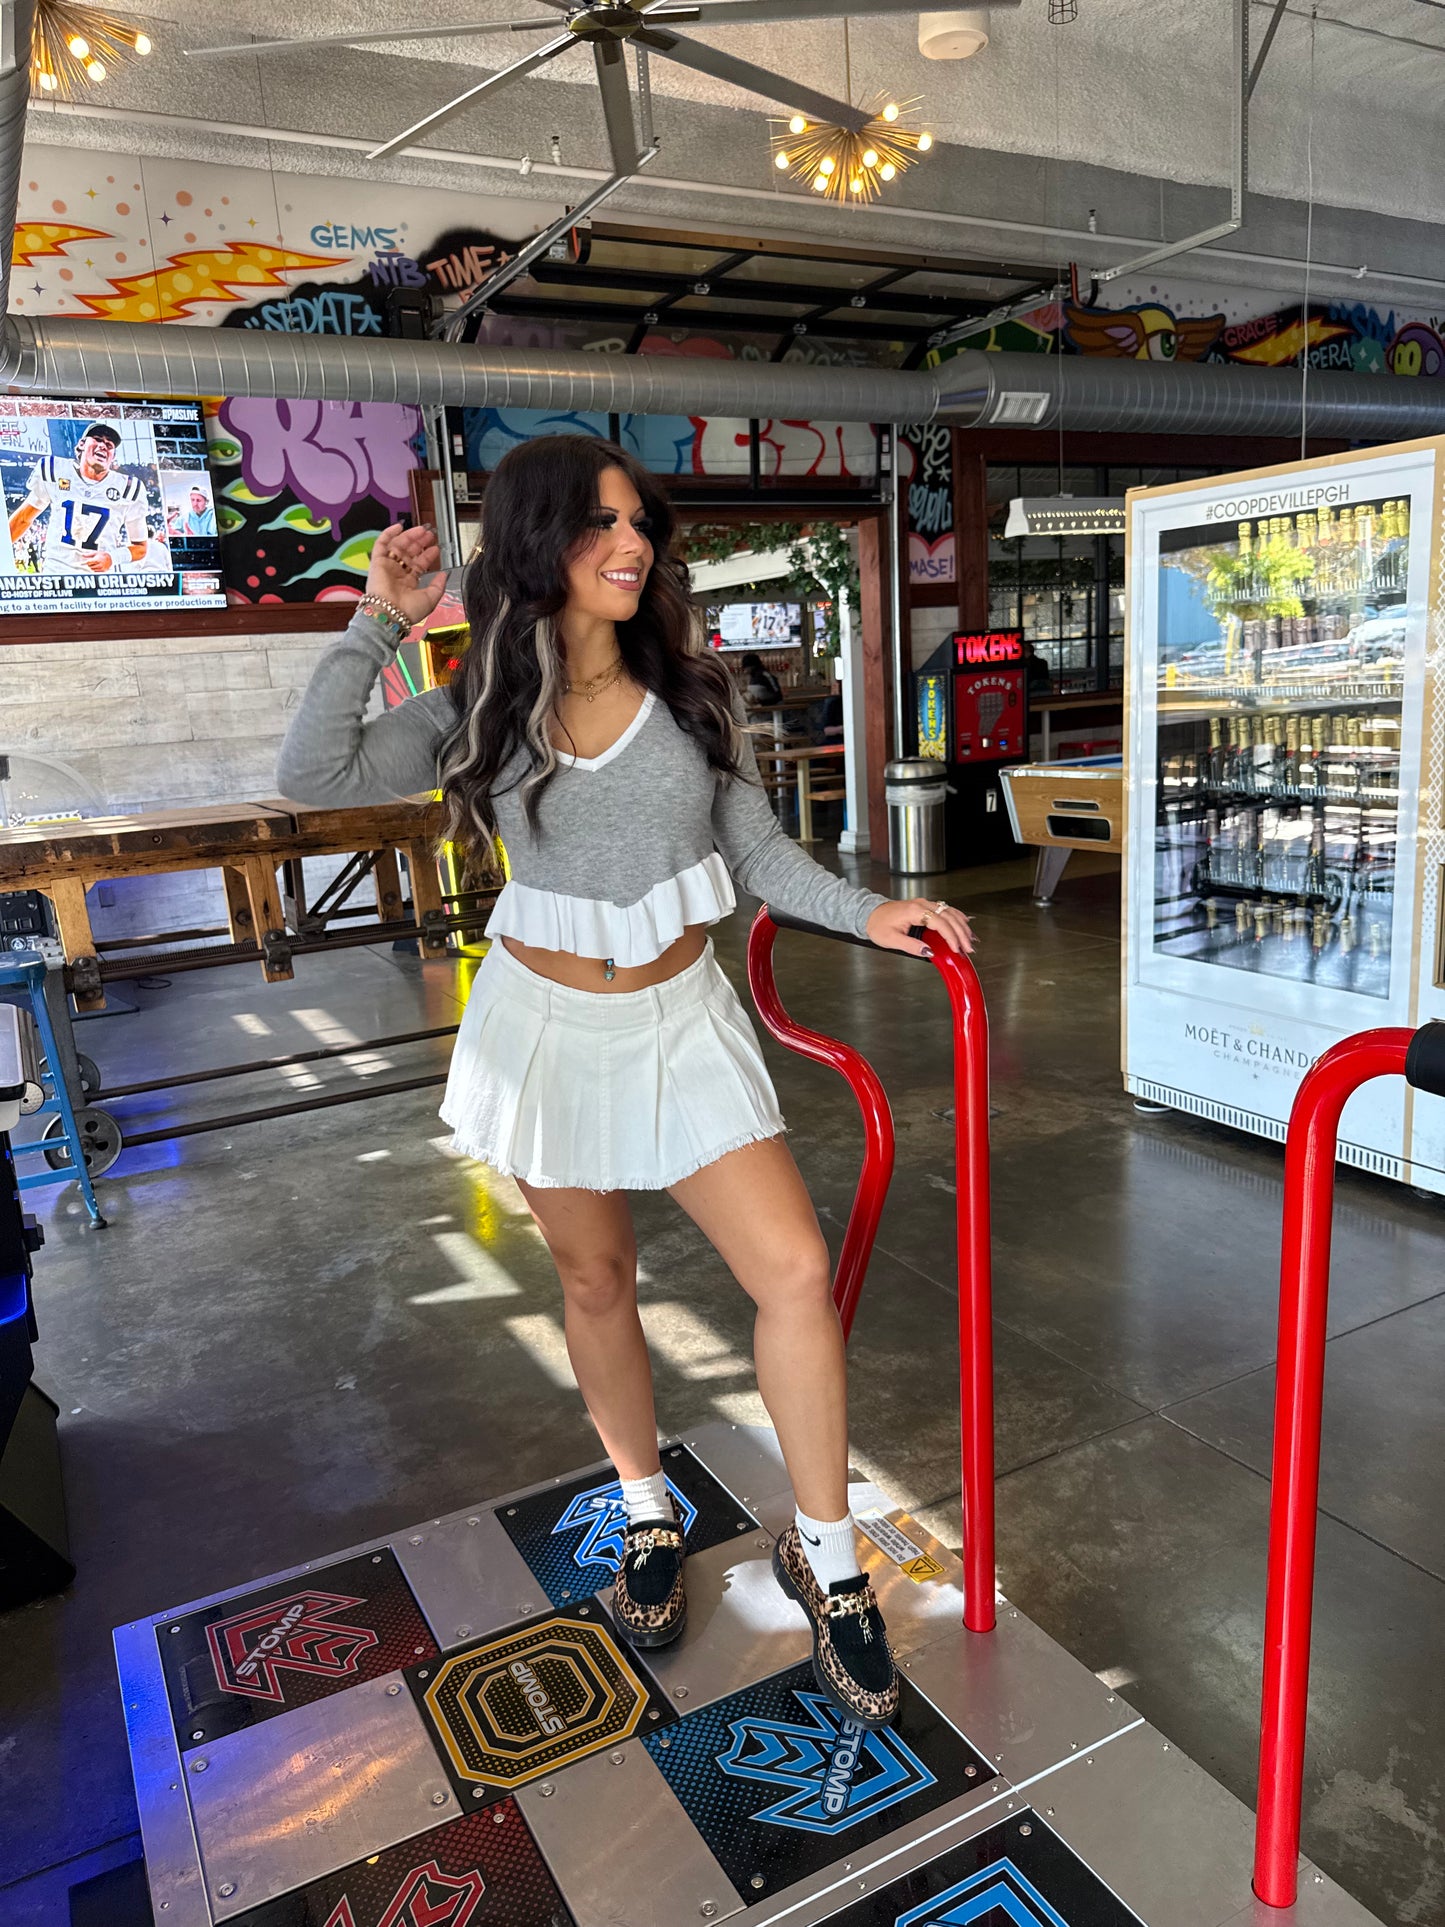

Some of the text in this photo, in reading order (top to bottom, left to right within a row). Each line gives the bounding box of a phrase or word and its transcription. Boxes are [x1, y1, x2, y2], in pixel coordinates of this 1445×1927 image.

[1224, 314, 1278, 347] GRACE
[1205, 484, 1350, 520] #COOPDEVILLEPGH
[61, 499, 110, 550] 17
[2, 590, 32, 599] CO-HOST
[33, 590, 42, 598] OF
[64, 575, 96, 589] DAN
[98, 573, 175, 588] ORLOVSKY
[12, 603, 22, 611] to
[60, 601, 92, 611] facility
[109, 599, 152, 610] practices
[165, 598, 212, 607] production
[953, 632, 1022, 665] TOKENS
[967, 676, 1012, 695] TOKENS
[926, 678, 937, 739] TOKENS
[1233, 1038, 1243, 1053] &
[1213, 1051, 1300, 1080] CHAMPAGNE
[235, 1603, 304, 1678] STOMP
[510, 1661, 564, 1735] STOMP
[824, 1719, 862, 1813] STOMP
